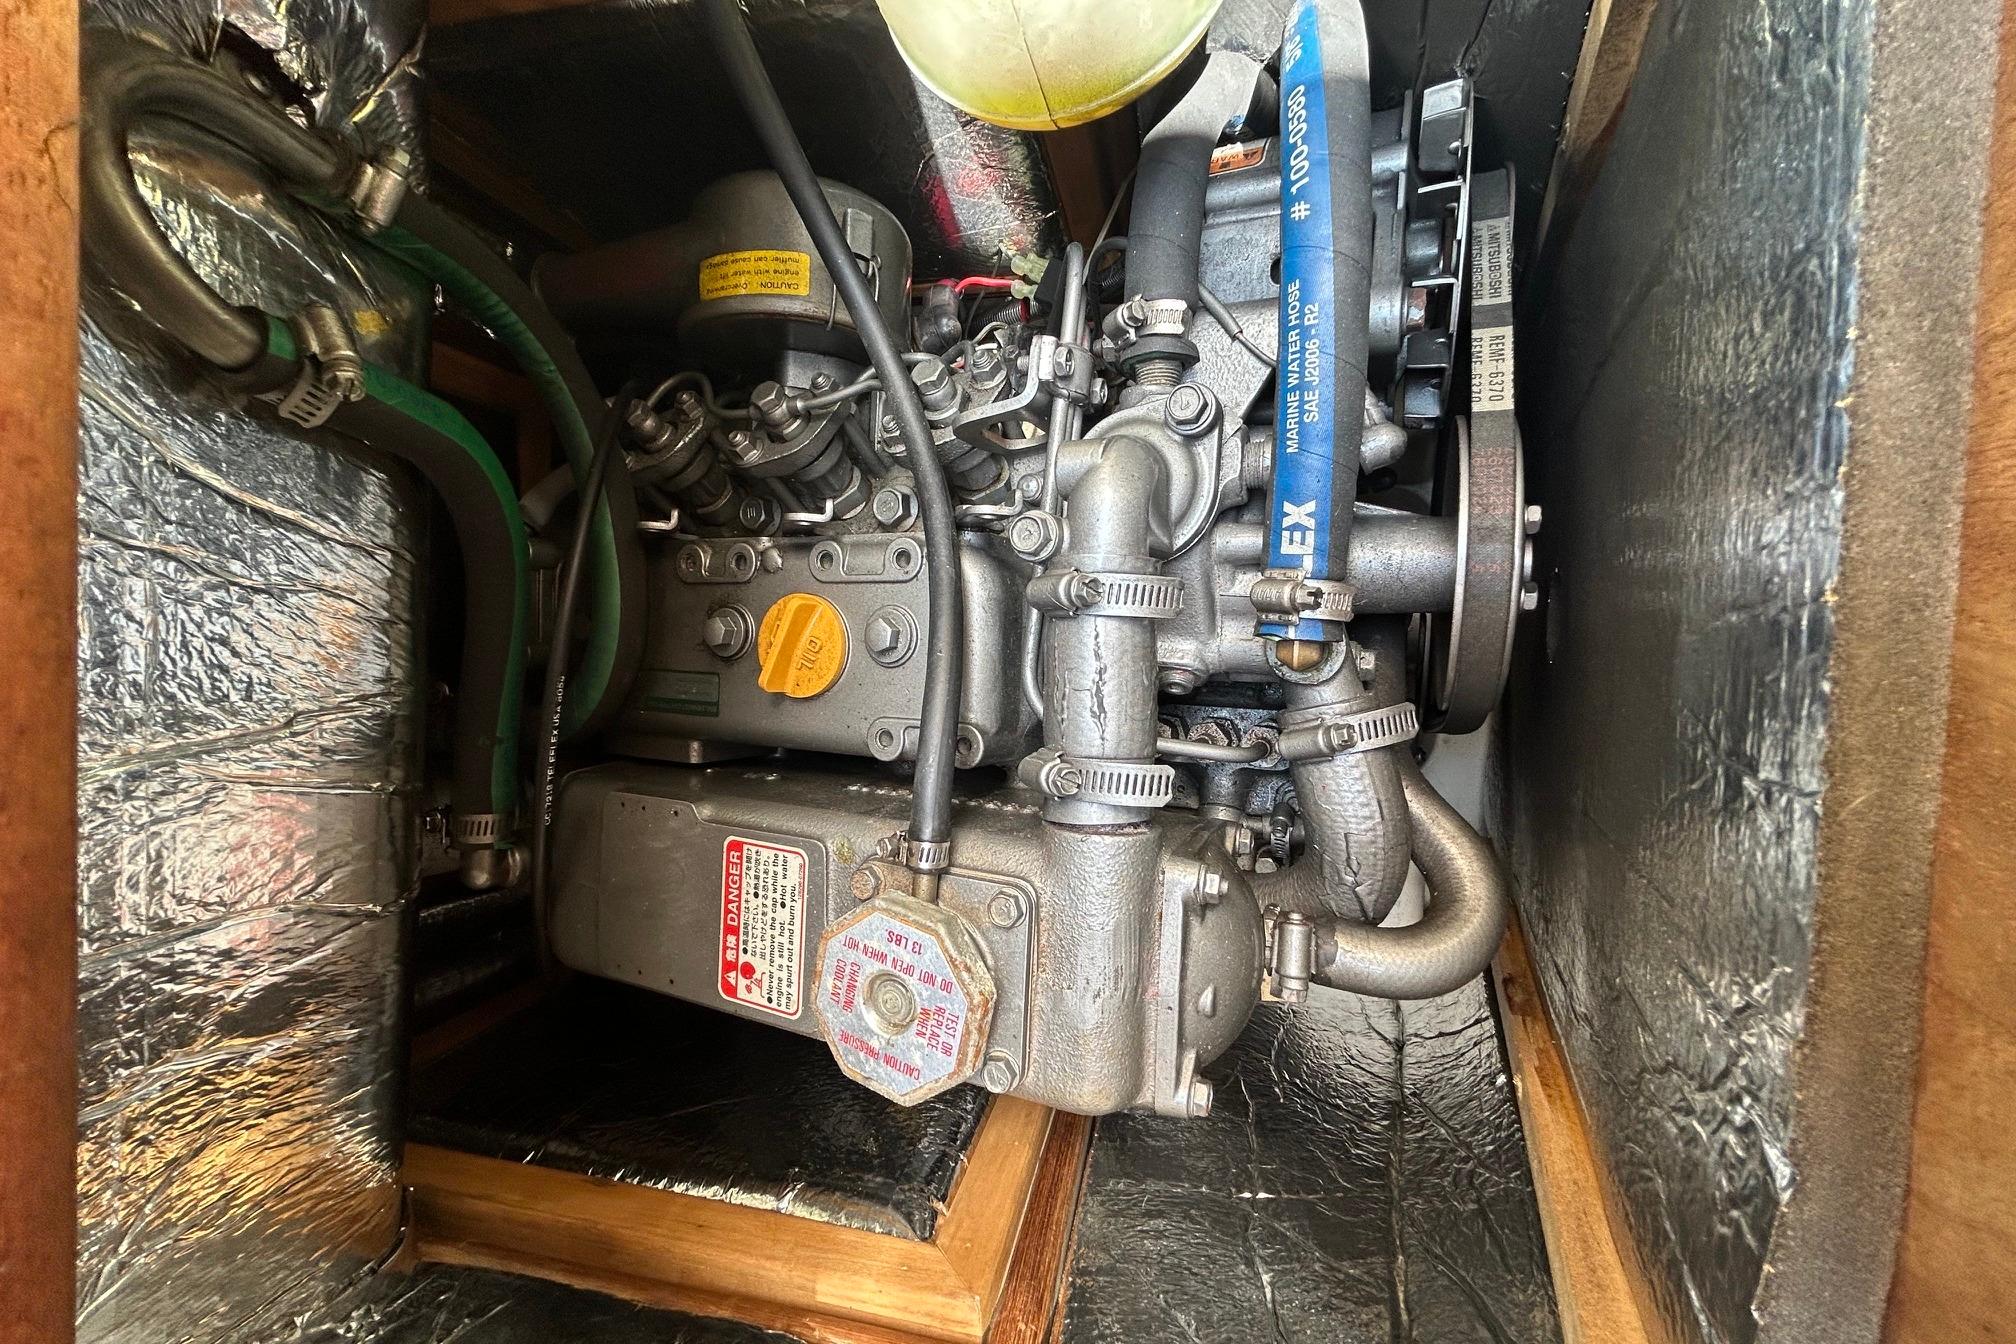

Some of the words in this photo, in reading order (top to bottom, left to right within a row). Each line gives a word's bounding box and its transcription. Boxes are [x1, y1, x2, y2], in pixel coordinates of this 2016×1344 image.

[1287, 84, 1310, 196] 100-0580
[1290, 200, 1311, 221] #
[1487, 232, 1502, 298] MITSUBOSHI
[1287, 278, 1300, 327] HOSE
[1303, 302, 1319, 326] R2
[1287, 329, 1300, 388] WATER
[1304, 338, 1320, 386] J2006
[1489, 335, 1505, 402] REMF-6370
[1303, 389, 1319, 423] SAE
[1286, 392, 1299, 454] MARINE
[1280, 500, 1316, 572] EX
[795, 635, 823, 671] OIL
[553, 705, 561, 727] USA
[727, 850, 741, 926] DANGER
[779, 885, 787, 900] Hot
[789, 883, 797, 903] you.
[770, 897, 779, 914] cap
[787, 905, 796, 926] burn
[725, 934, 737, 962] 危険
[768, 934, 776, 967] remove
[787, 929, 795, 946] and
[842, 935, 860, 951] HOT
[884, 929, 909, 950] LBS.
[911, 942, 923, 955] 13
[862, 946, 888, 966] WHEN
[891, 961, 914, 976] OPEN
[766, 970, 775, 996] Never
[785, 965, 794, 989] spurt
[830, 958, 847, 1005] COOLANT
[842, 962, 861, 1014] CHANGING
[918, 969, 936, 987] NOT
[940, 981, 953, 995] DO
[776, 977, 784, 1008] engine
[785, 991, 793, 1010] may
[915, 1007, 932, 1038] WHEN
[926, 1005, 946, 1051] REPLACE
[946, 1013, 960, 1038] TEST
[839, 1029, 879, 1060] PRESSURE
[941, 1039, 953, 1057] OR
[883, 1054, 920, 1081] CAUTION
